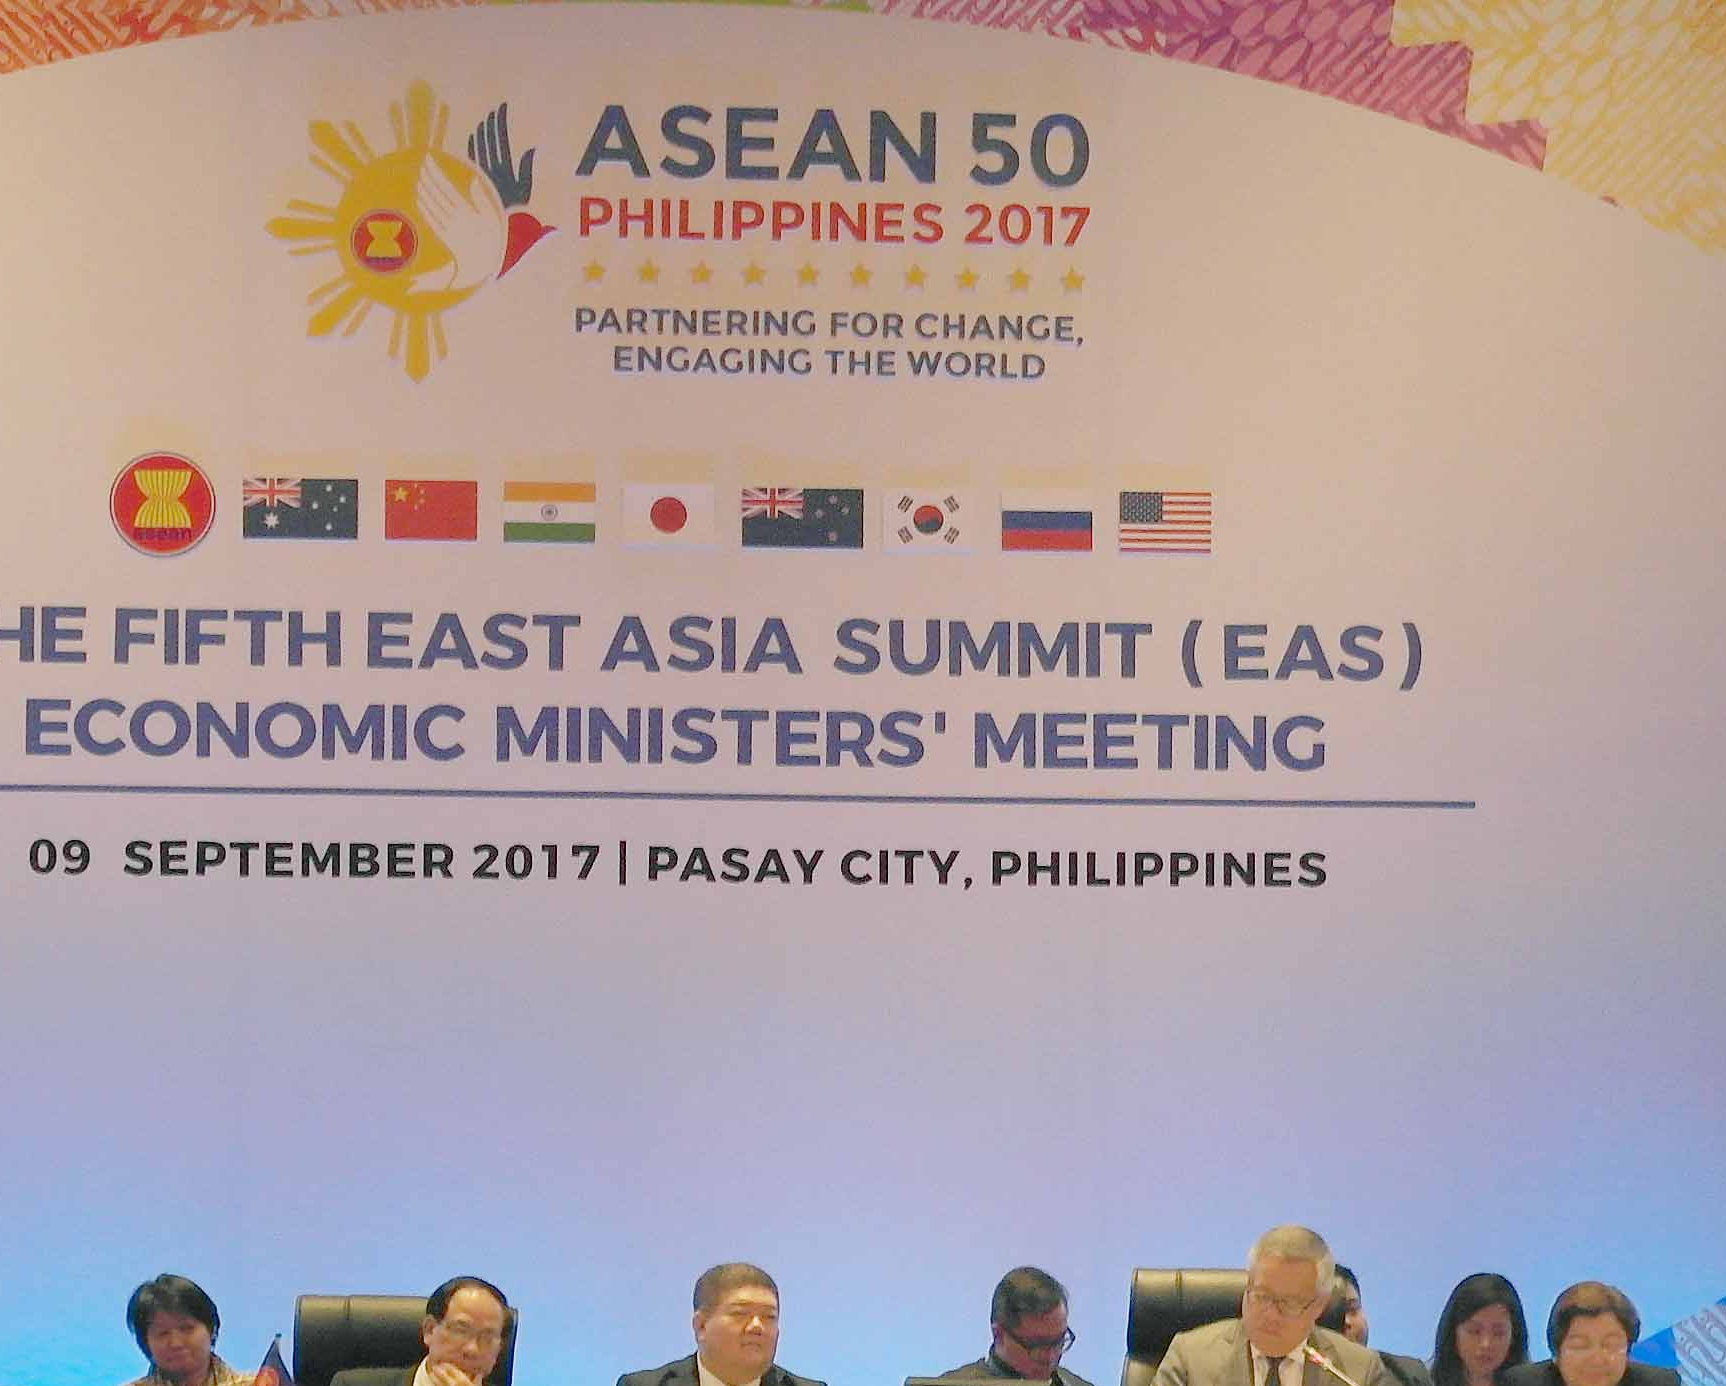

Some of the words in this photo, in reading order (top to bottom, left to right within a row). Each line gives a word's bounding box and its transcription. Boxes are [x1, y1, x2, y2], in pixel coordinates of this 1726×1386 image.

[576, 106, 936, 181] ASEAN
[970, 114, 1089, 186] 50
[580, 198, 943, 242] PHILIPPINES
[965, 204, 1090, 245] 2017
[576, 308, 815, 336] PARTNERING
[831, 312, 903, 338] FOR
[915, 314, 1083, 343] CHANGE,
[614, 346, 811, 373] ENGAGING
[825, 351, 895, 376] THE
[907, 351, 1045, 378] WORLD
[114, 609, 341, 666] FIFTH
[367, 613, 581, 669] EAST
[600, 616, 803, 673] ASIA
[834, 620, 1152, 677] SUMMIT
[26, 700, 465, 759] ECONOMIC
[497, 708, 945, 766] MINISTERS'
[975, 714, 1325, 769] MEETING
[30, 840, 90, 874] 09
[124, 841, 453, 877] SEPTEMBER
[473, 845, 599, 879] 2017
[649, 847, 824, 883] PASAY
[841, 850, 972, 886] CITY,
[992, 852, 1326, 886] PHILIPPINES
